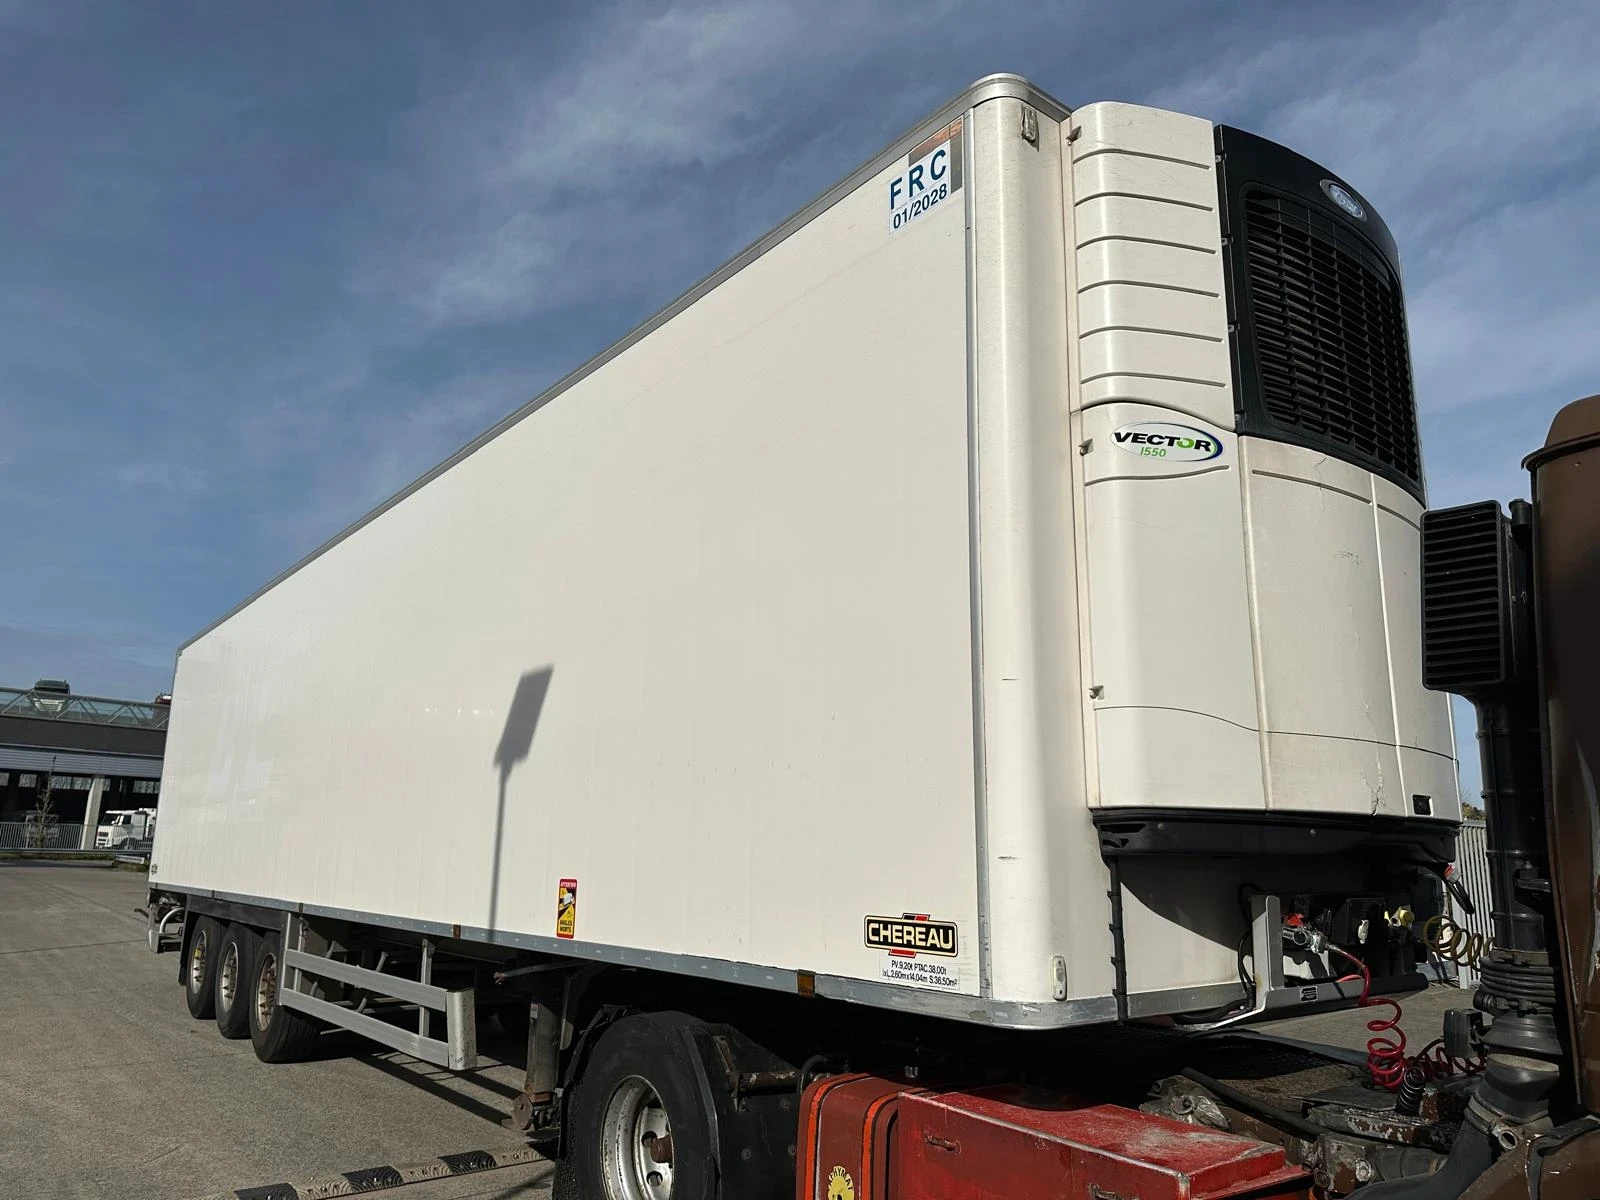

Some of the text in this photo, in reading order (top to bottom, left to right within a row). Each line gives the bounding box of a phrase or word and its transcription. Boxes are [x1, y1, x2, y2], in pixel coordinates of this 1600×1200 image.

[893, 183, 948, 229] 01/2028
[1114, 432, 1211, 452] VECTOR
[1140, 446, 1167, 458] 1550
[868, 923, 952, 949] CHEREAU
